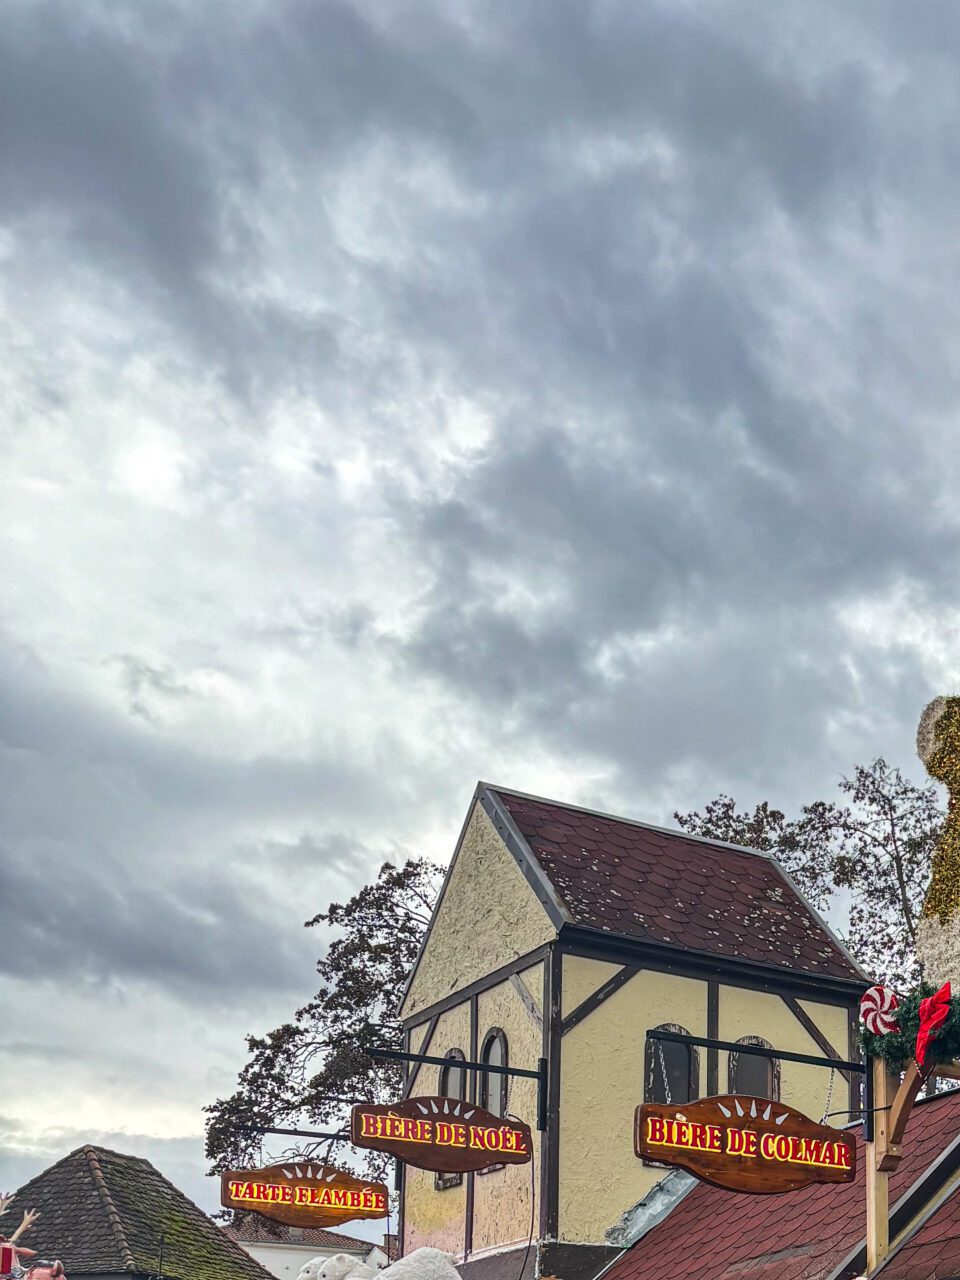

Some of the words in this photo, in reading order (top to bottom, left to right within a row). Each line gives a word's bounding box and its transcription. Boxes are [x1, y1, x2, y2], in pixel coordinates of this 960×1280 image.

[361, 1111, 432, 1143] BIÈRE
[436, 1122, 466, 1147] DE
[470, 1126, 527, 1154] NOËL
[727, 1128, 757, 1157] DE
[761, 1133, 851, 1169] COLMAR
[229, 1181, 292, 1204] TARTE
[295, 1186, 385, 1211] FLAMBÉE
